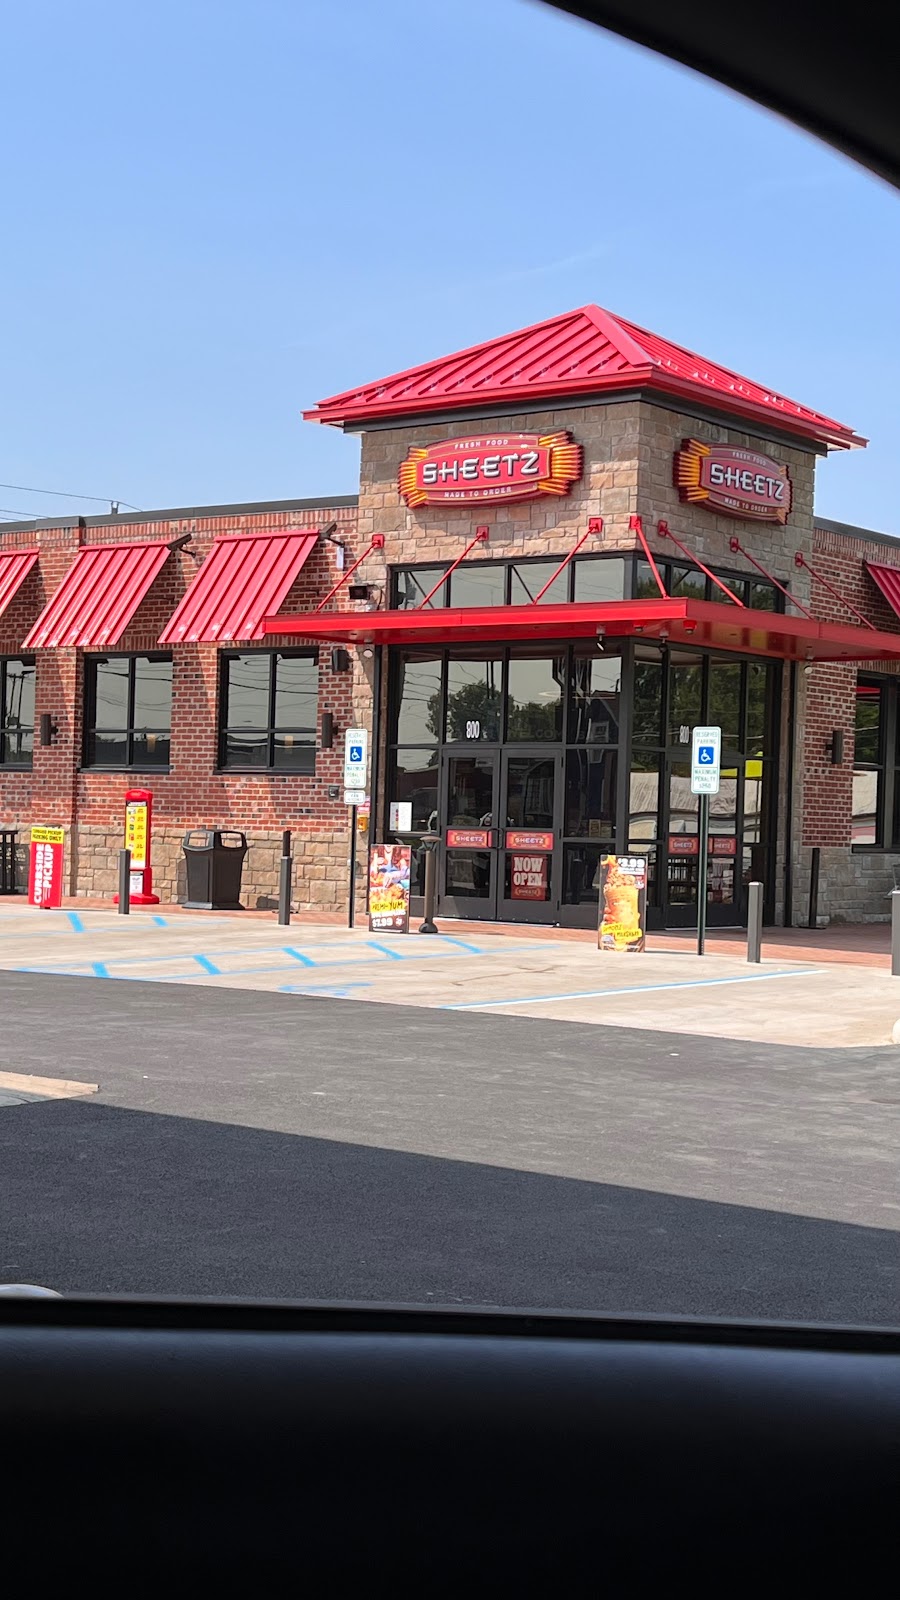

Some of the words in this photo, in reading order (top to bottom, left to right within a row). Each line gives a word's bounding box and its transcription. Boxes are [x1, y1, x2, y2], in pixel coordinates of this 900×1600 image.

[454, 441, 481, 450] FRESH
[732, 451, 752, 461] FRESH
[753, 455, 767, 466] FOOD
[422, 451, 539, 484] SHEETZ
[710, 463, 785, 500] SHEETZ
[483, 486, 512, 495] ORDER
[724, 497, 740, 507] MADE
[742, 502, 749, 510] TO
[750, 505, 768, 513] ORDER
[466, 720, 480, 739] 800
[680, 725, 690, 743] 800
[33, 843, 45, 904] CURBSIDE
[42, 843, 54, 889] PICKUP
[513, 857, 543, 873] NOW
[513, 872, 543, 886] OPEN
